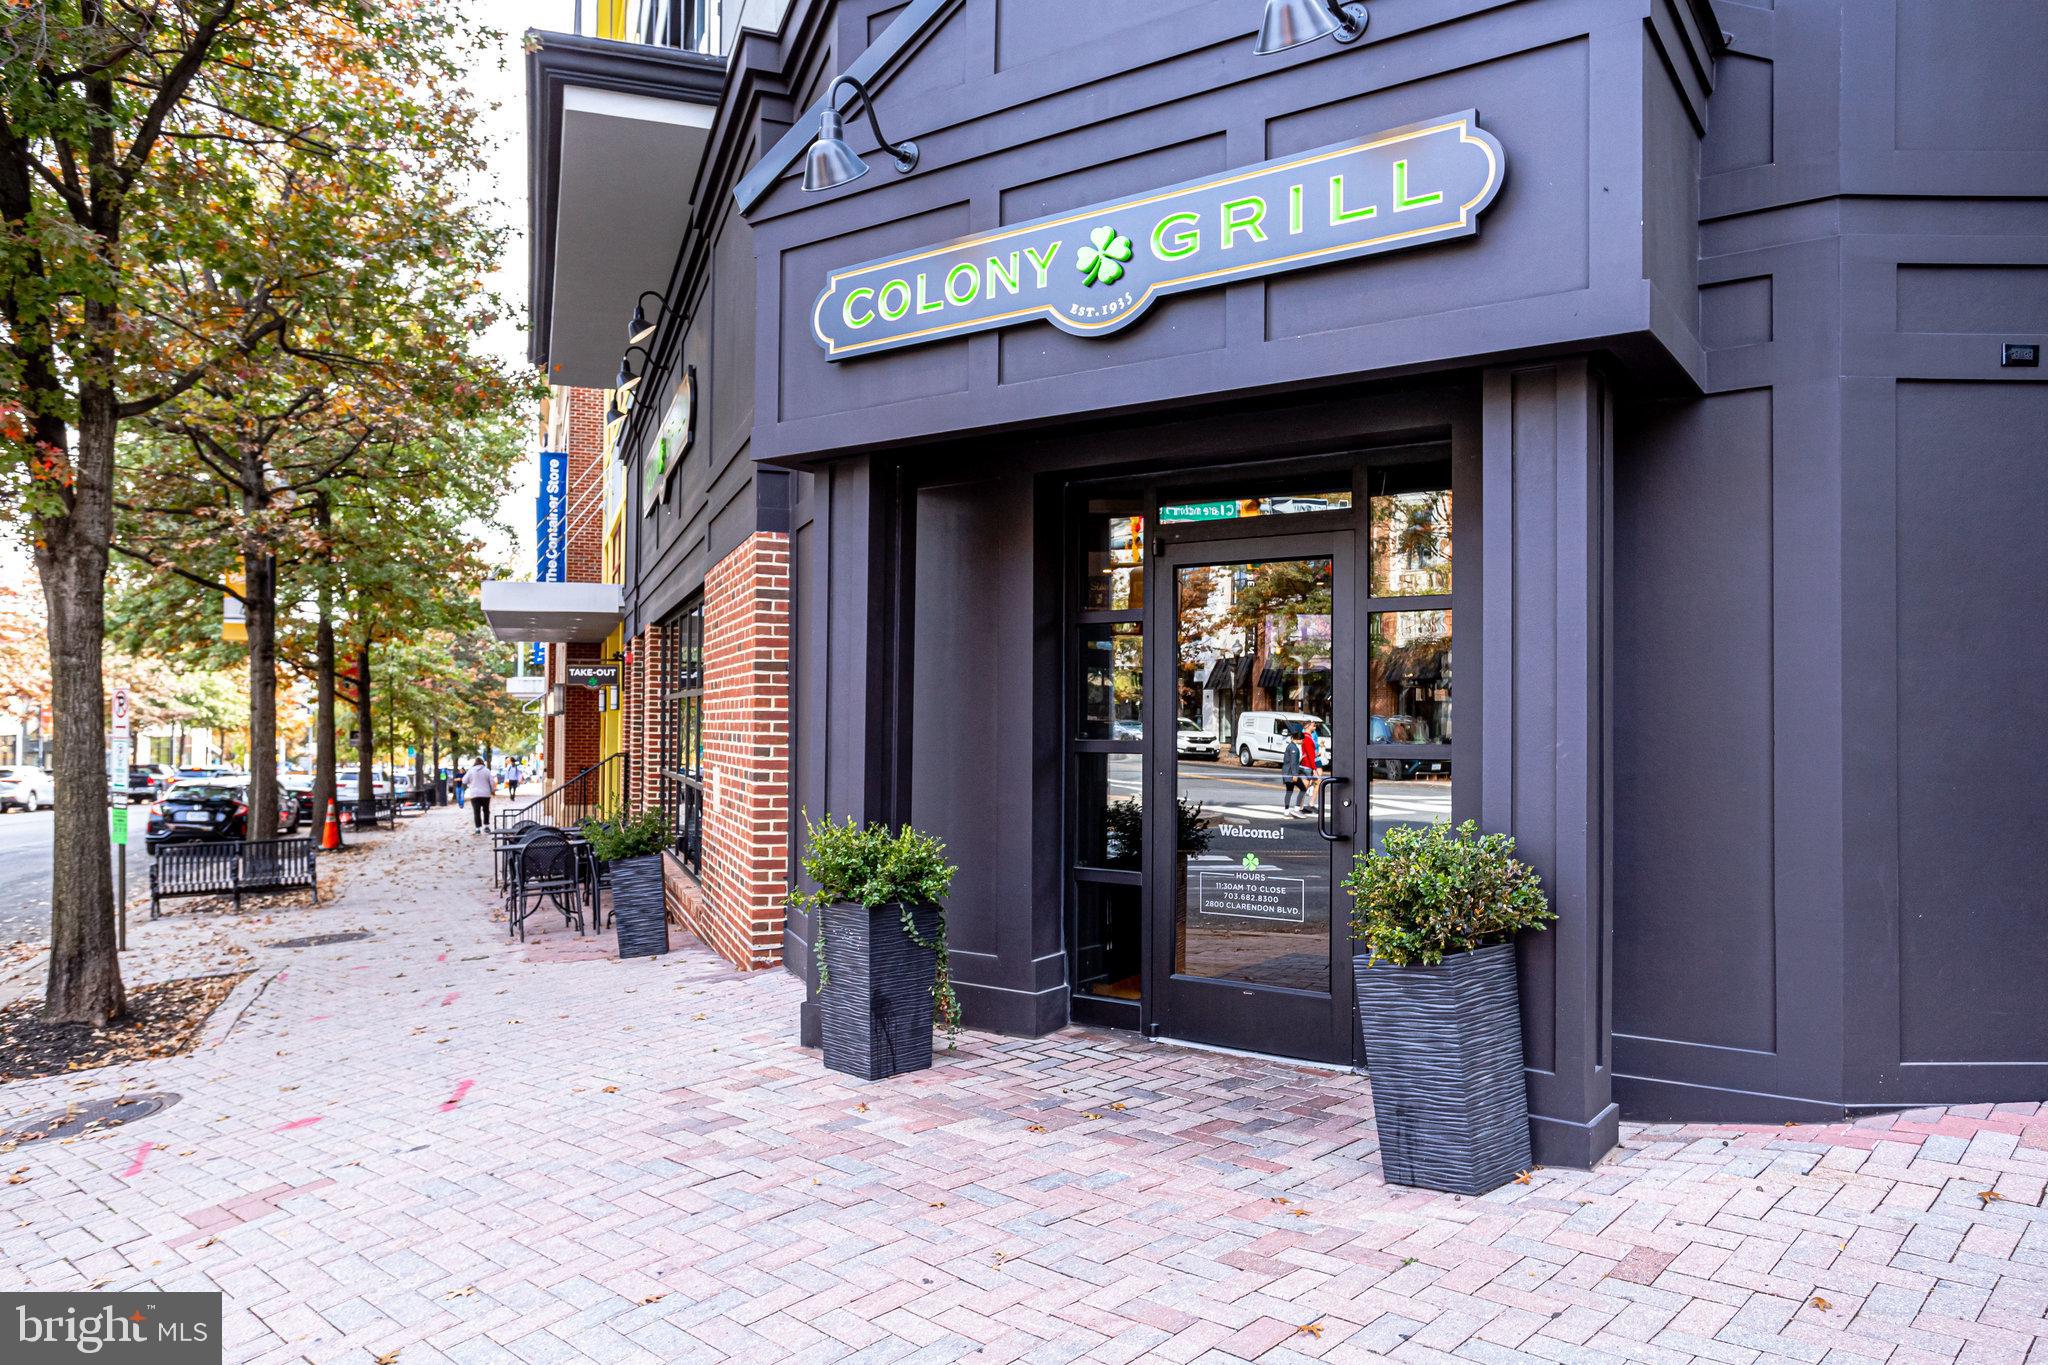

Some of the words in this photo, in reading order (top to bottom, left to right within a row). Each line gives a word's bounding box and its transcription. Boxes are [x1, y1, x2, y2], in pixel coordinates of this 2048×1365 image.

[842, 241, 1063, 330] COLONY
[1149, 159, 1443, 262] GRILL
[1069, 303, 1100, 318] EST.
[1102, 291, 1133, 315] 1935
[545, 458, 560, 494] Store
[545, 495, 560, 559] Container
[568, 668, 617, 677] TAKE-OUT
[1218, 824, 1284, 839] Welcome!
[1236, 873, 1265, 881] HOURS
[1215, 882, 1244, 890] 11:30AM
[1246, 884, 1257, 892] TO
[1259, 886, 1286, 894] CLOSE
[1223, 892, 1279, 903] 703.682.8300
[1205, 900, 1224, 908] 2800
[1226, 902, 1275, 912] CLARENDON
[1276, 907, 1301, 915] BLVD.
